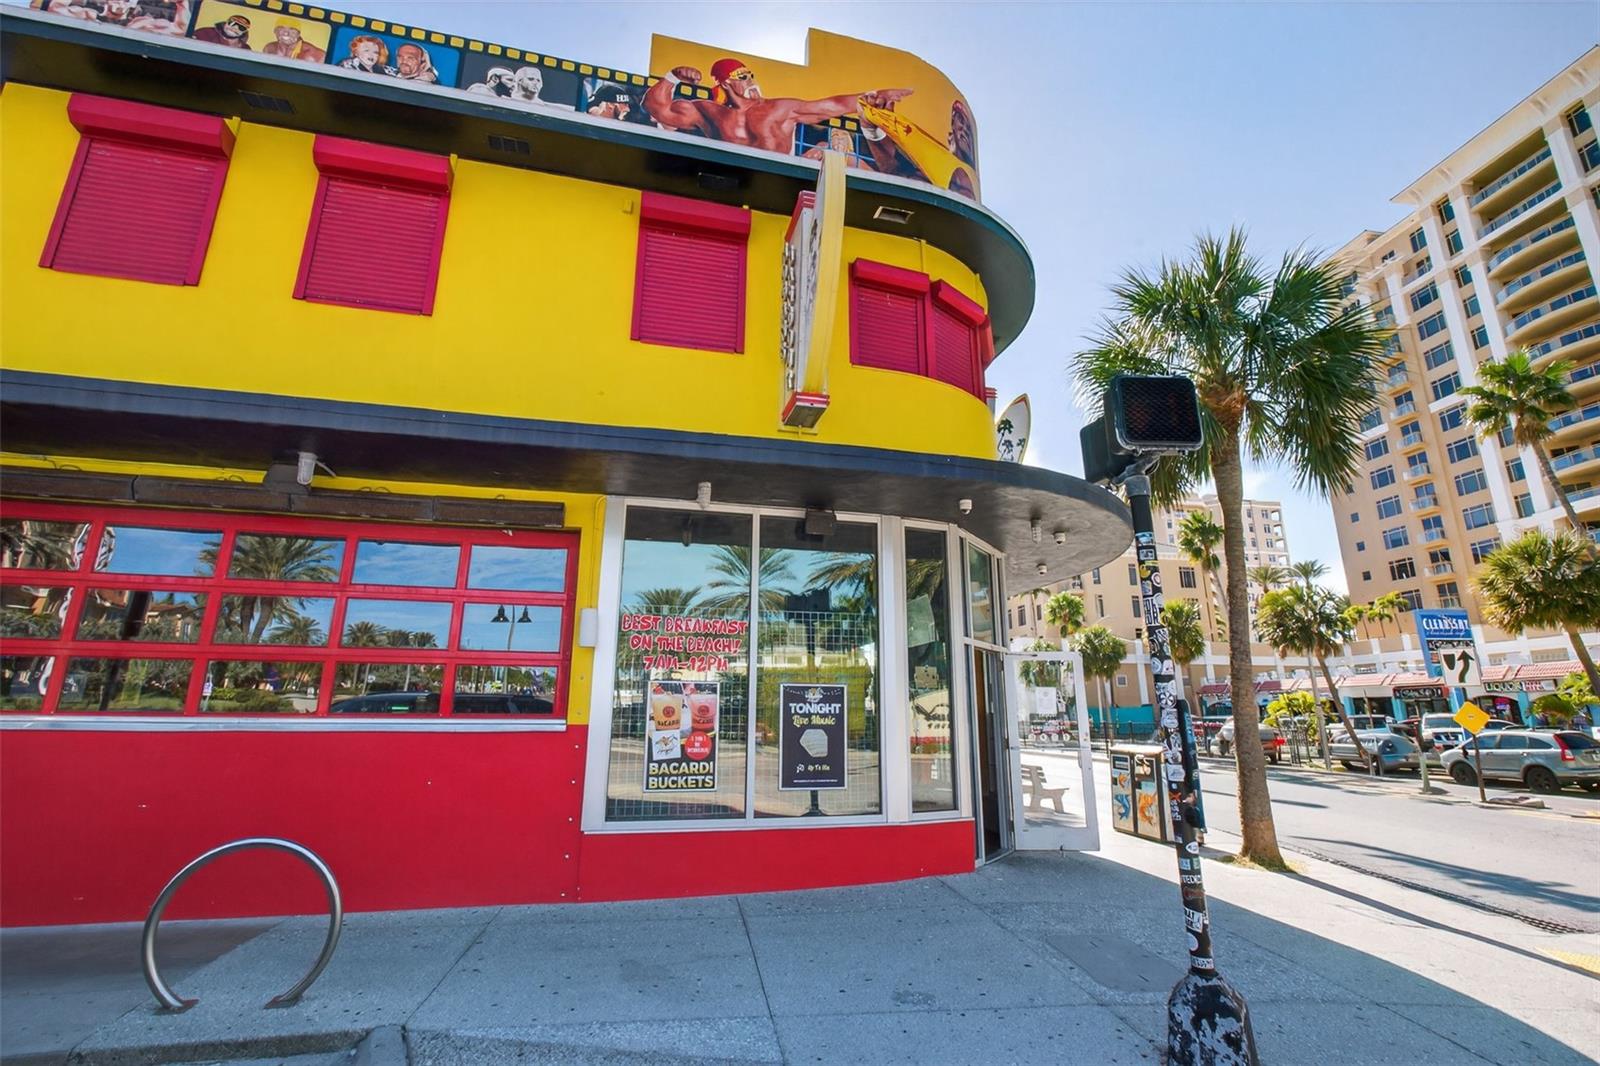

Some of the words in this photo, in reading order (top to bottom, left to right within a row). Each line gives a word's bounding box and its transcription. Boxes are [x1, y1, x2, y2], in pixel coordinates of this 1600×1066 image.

[621, 613, 661, 631] BEST
[665, 616, 748, 634] BREAKFAST
[630, 633, 653, 650] ON
[656, 635, 684, 652] THE
[686, 636, 742, 655] BEACH!
[789, 703, 841, 714] TONIGHT
[792, 715, 809, 727] Live
[811, 715, 836, 725] Music
[649, 761, 713, 775] BACARDI
[648, 775, 714, 789] BUCKETS
